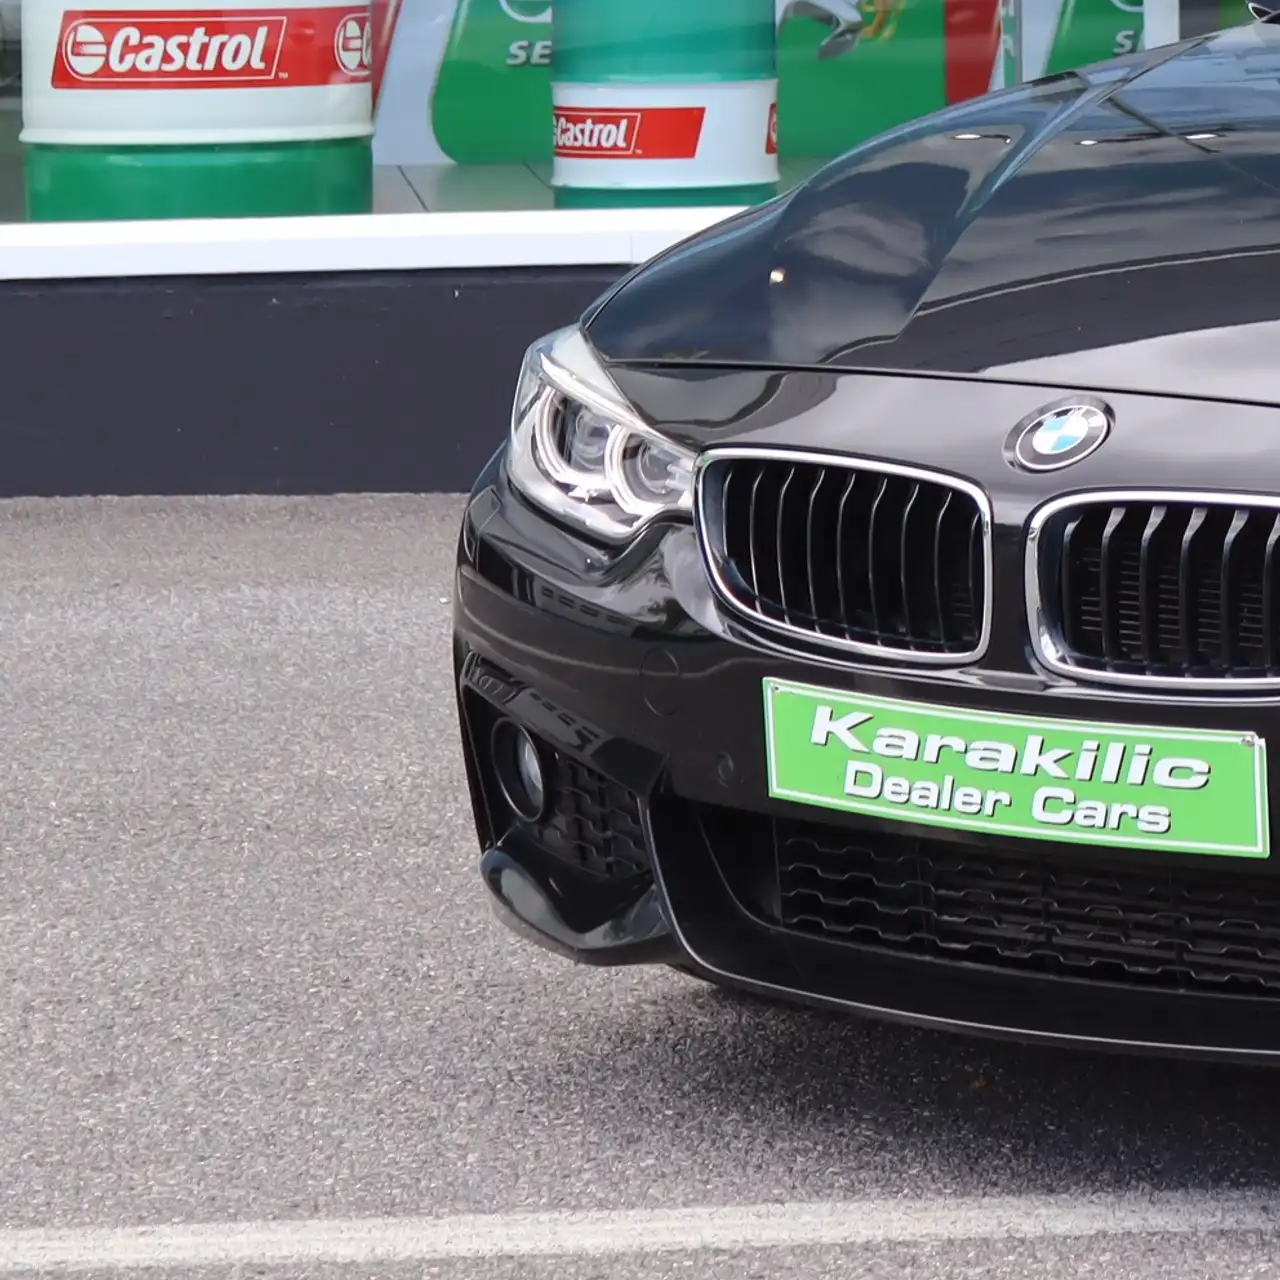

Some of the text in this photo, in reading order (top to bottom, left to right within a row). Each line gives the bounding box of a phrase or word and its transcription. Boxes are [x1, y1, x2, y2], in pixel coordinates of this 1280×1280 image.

[109, 26, 268, 73] Castrol
[556, 117, 628, 148] Castrol
[811, 705, 1211, 790] Karakilic
[844, 759, 1172, 834] Dealer Cars
